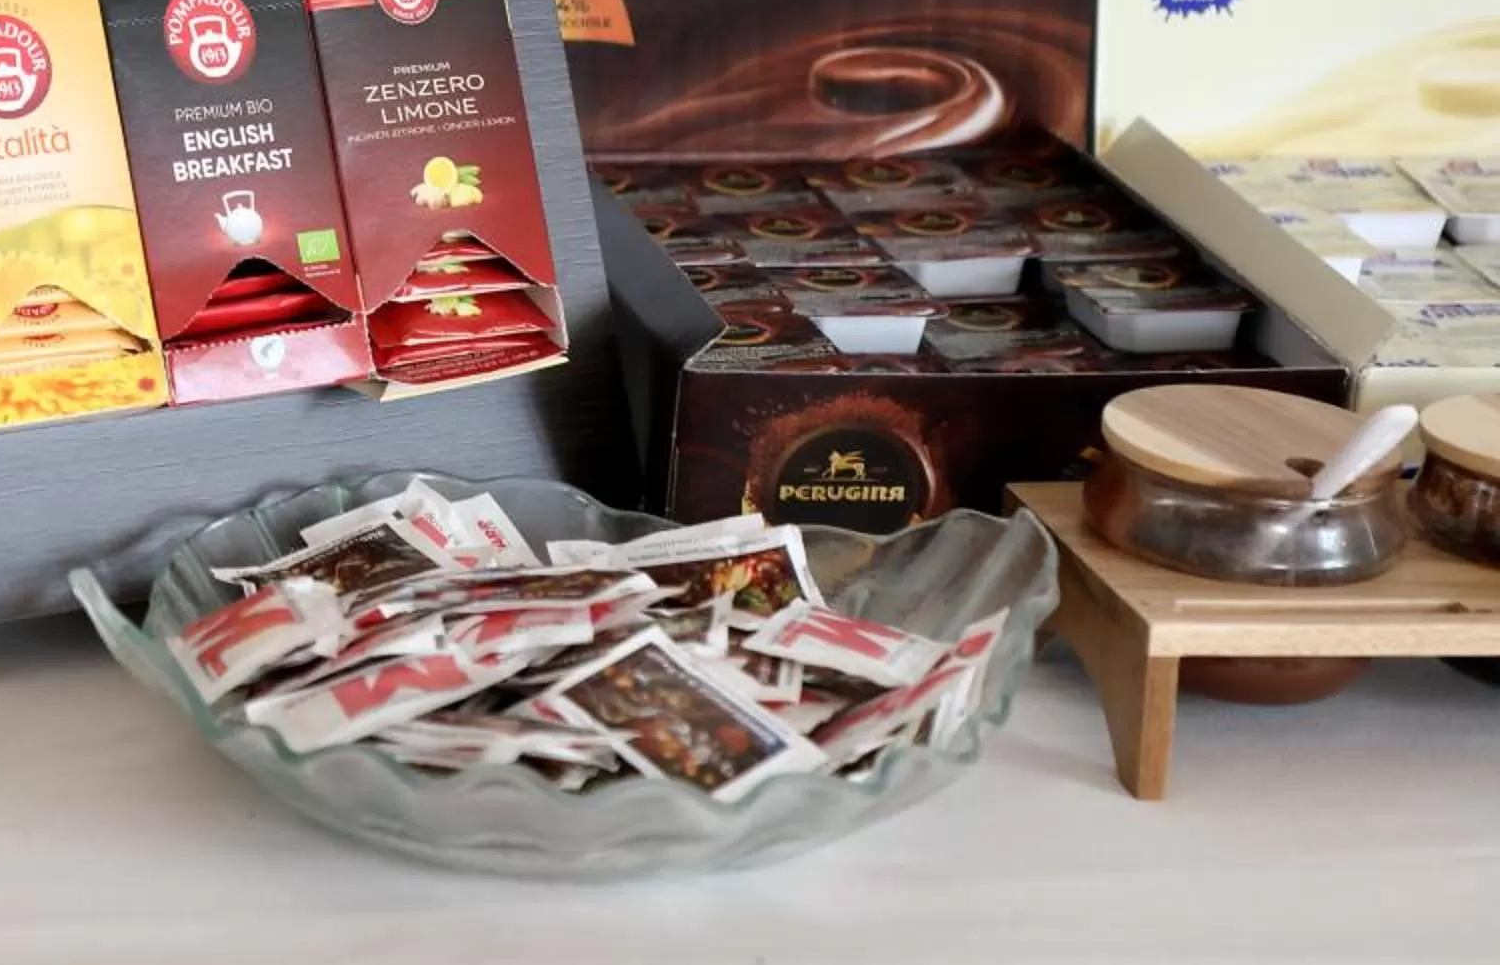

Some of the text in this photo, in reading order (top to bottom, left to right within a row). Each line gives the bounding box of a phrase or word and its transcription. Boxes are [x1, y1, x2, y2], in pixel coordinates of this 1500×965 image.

[363, 74, 485, 103] ZENZERO
[175, 98, 273, 123] PREMIUM BIO
[381, 97, 479, 124] LIMONE
[183, 123, 275, 152] ENGLISH
[173, 148, 293, 183] BREAKFAST
[779, 485, 905, 502] PERUGINA
